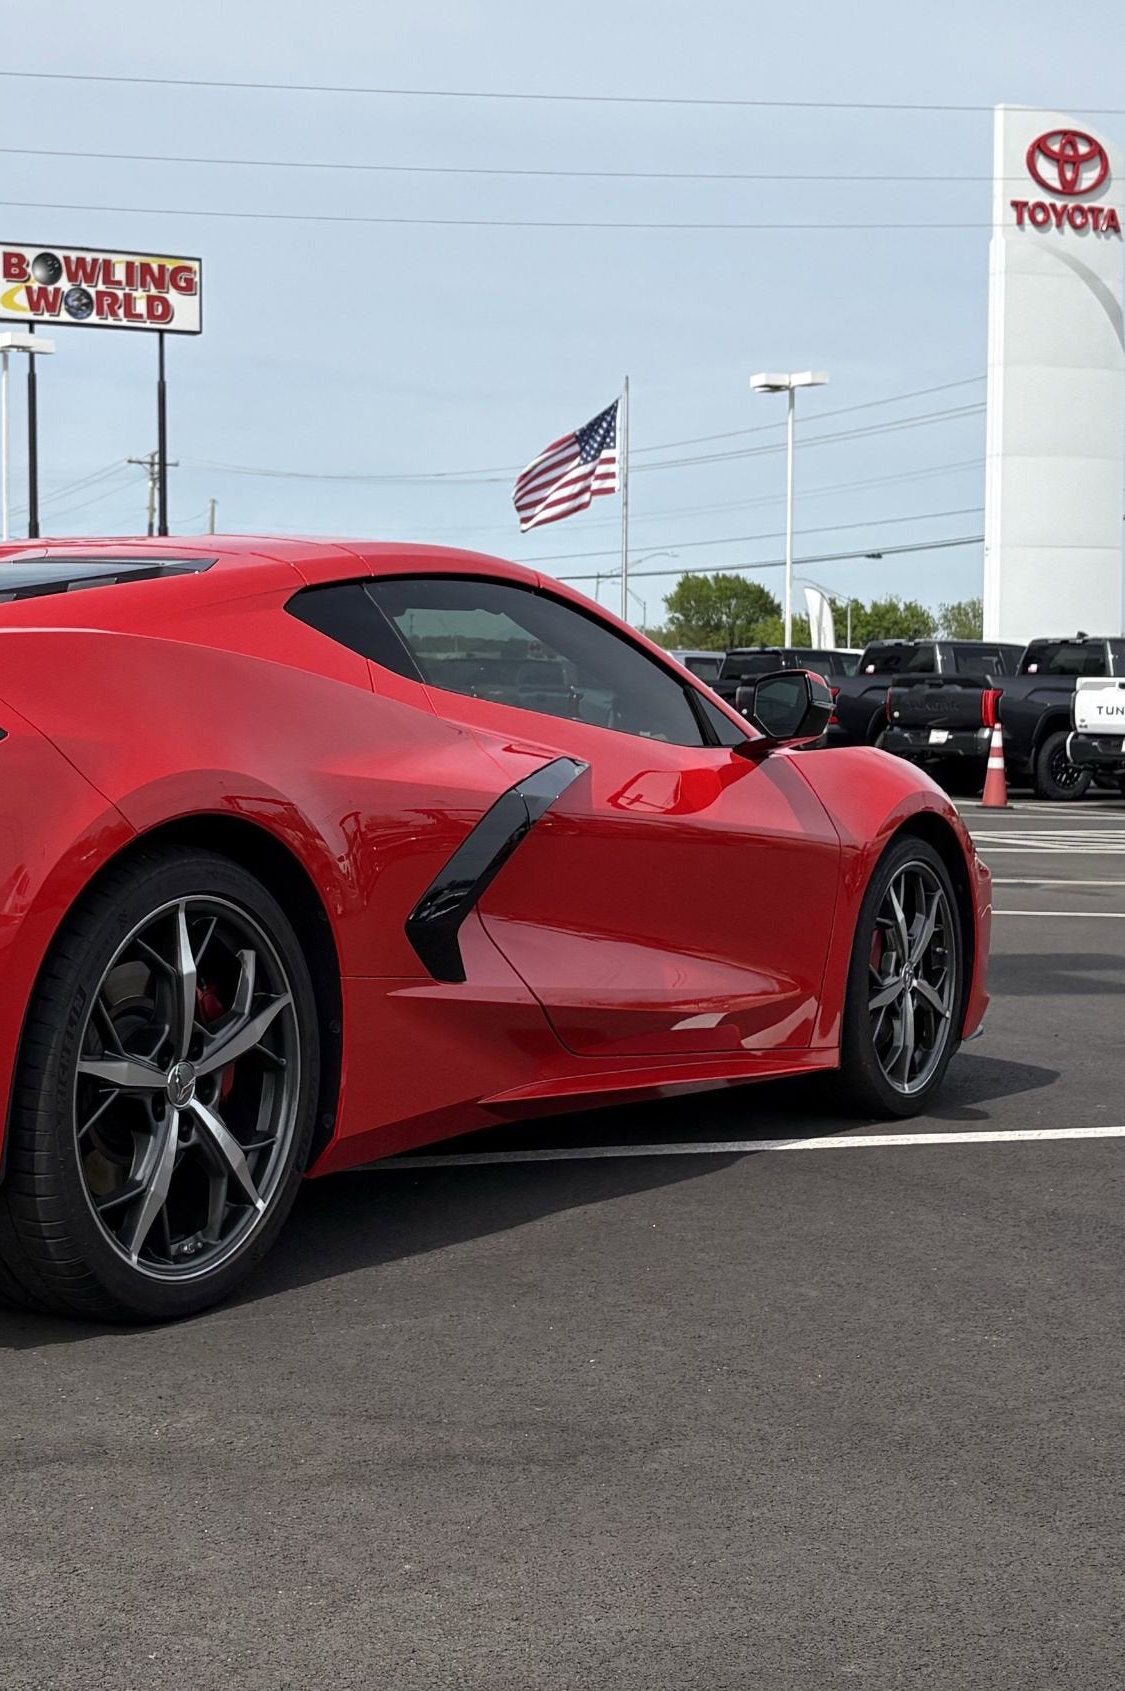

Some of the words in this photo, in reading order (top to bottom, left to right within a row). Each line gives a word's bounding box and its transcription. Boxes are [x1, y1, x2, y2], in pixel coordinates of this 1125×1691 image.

[1010, 200, 1121, 234] TOYOTA
[2, 252, 197, 296] BOWLING
[25, 286, 173, 324] WORLD
